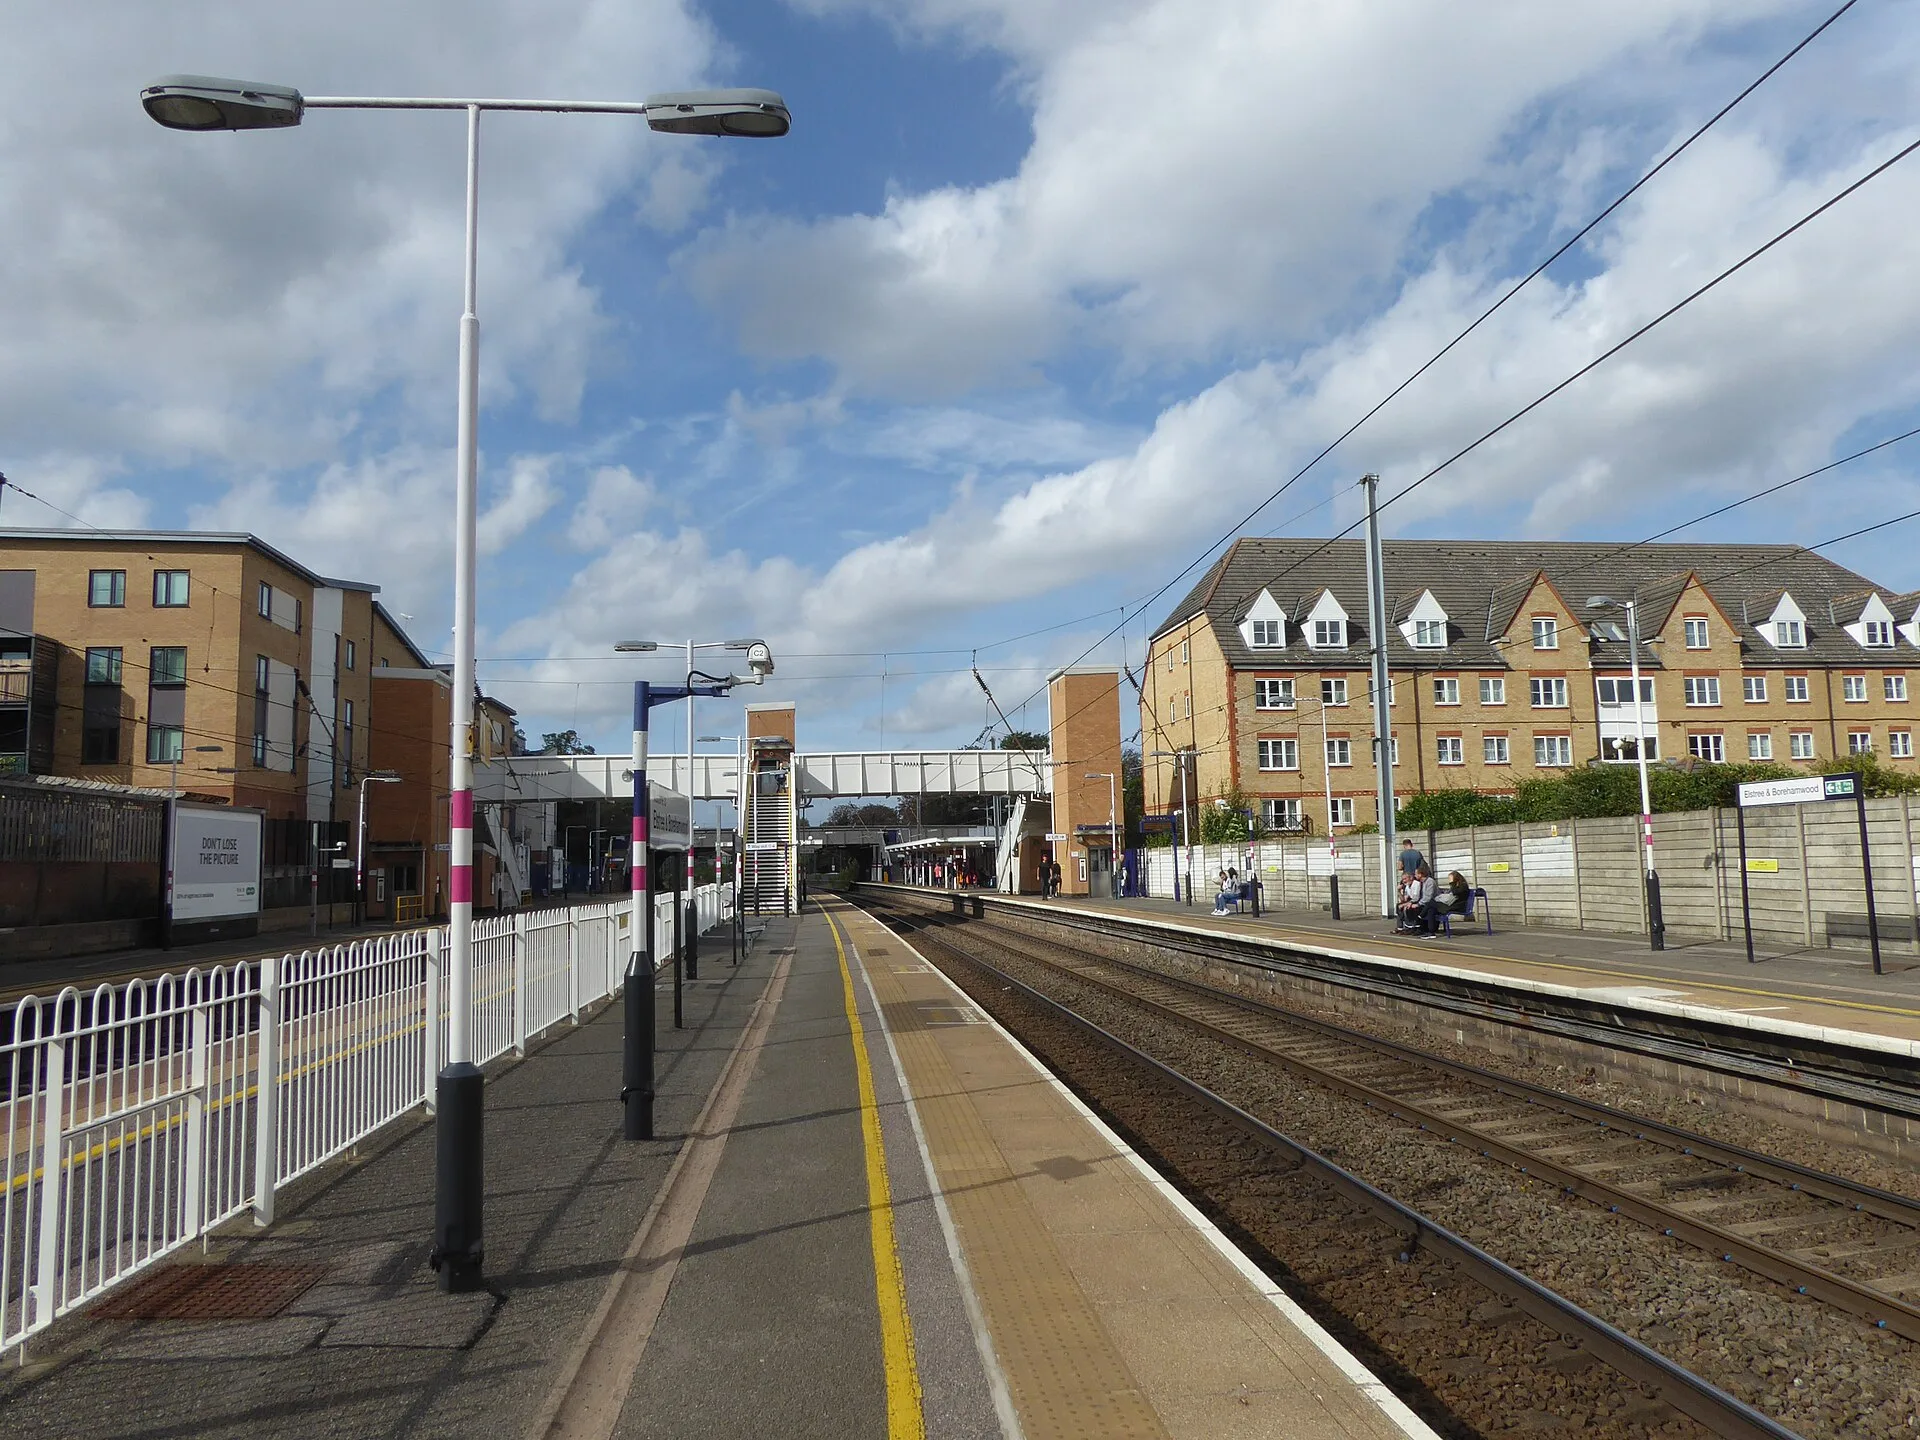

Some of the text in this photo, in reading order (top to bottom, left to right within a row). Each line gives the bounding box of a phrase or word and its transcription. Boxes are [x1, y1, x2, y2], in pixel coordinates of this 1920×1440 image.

[1744, 785, 1819, 799] Elstree & Borehamwood
[203, 838, 237, 850] DON'T LOSE
[200, 853, 238, 865] THE PICTURE
